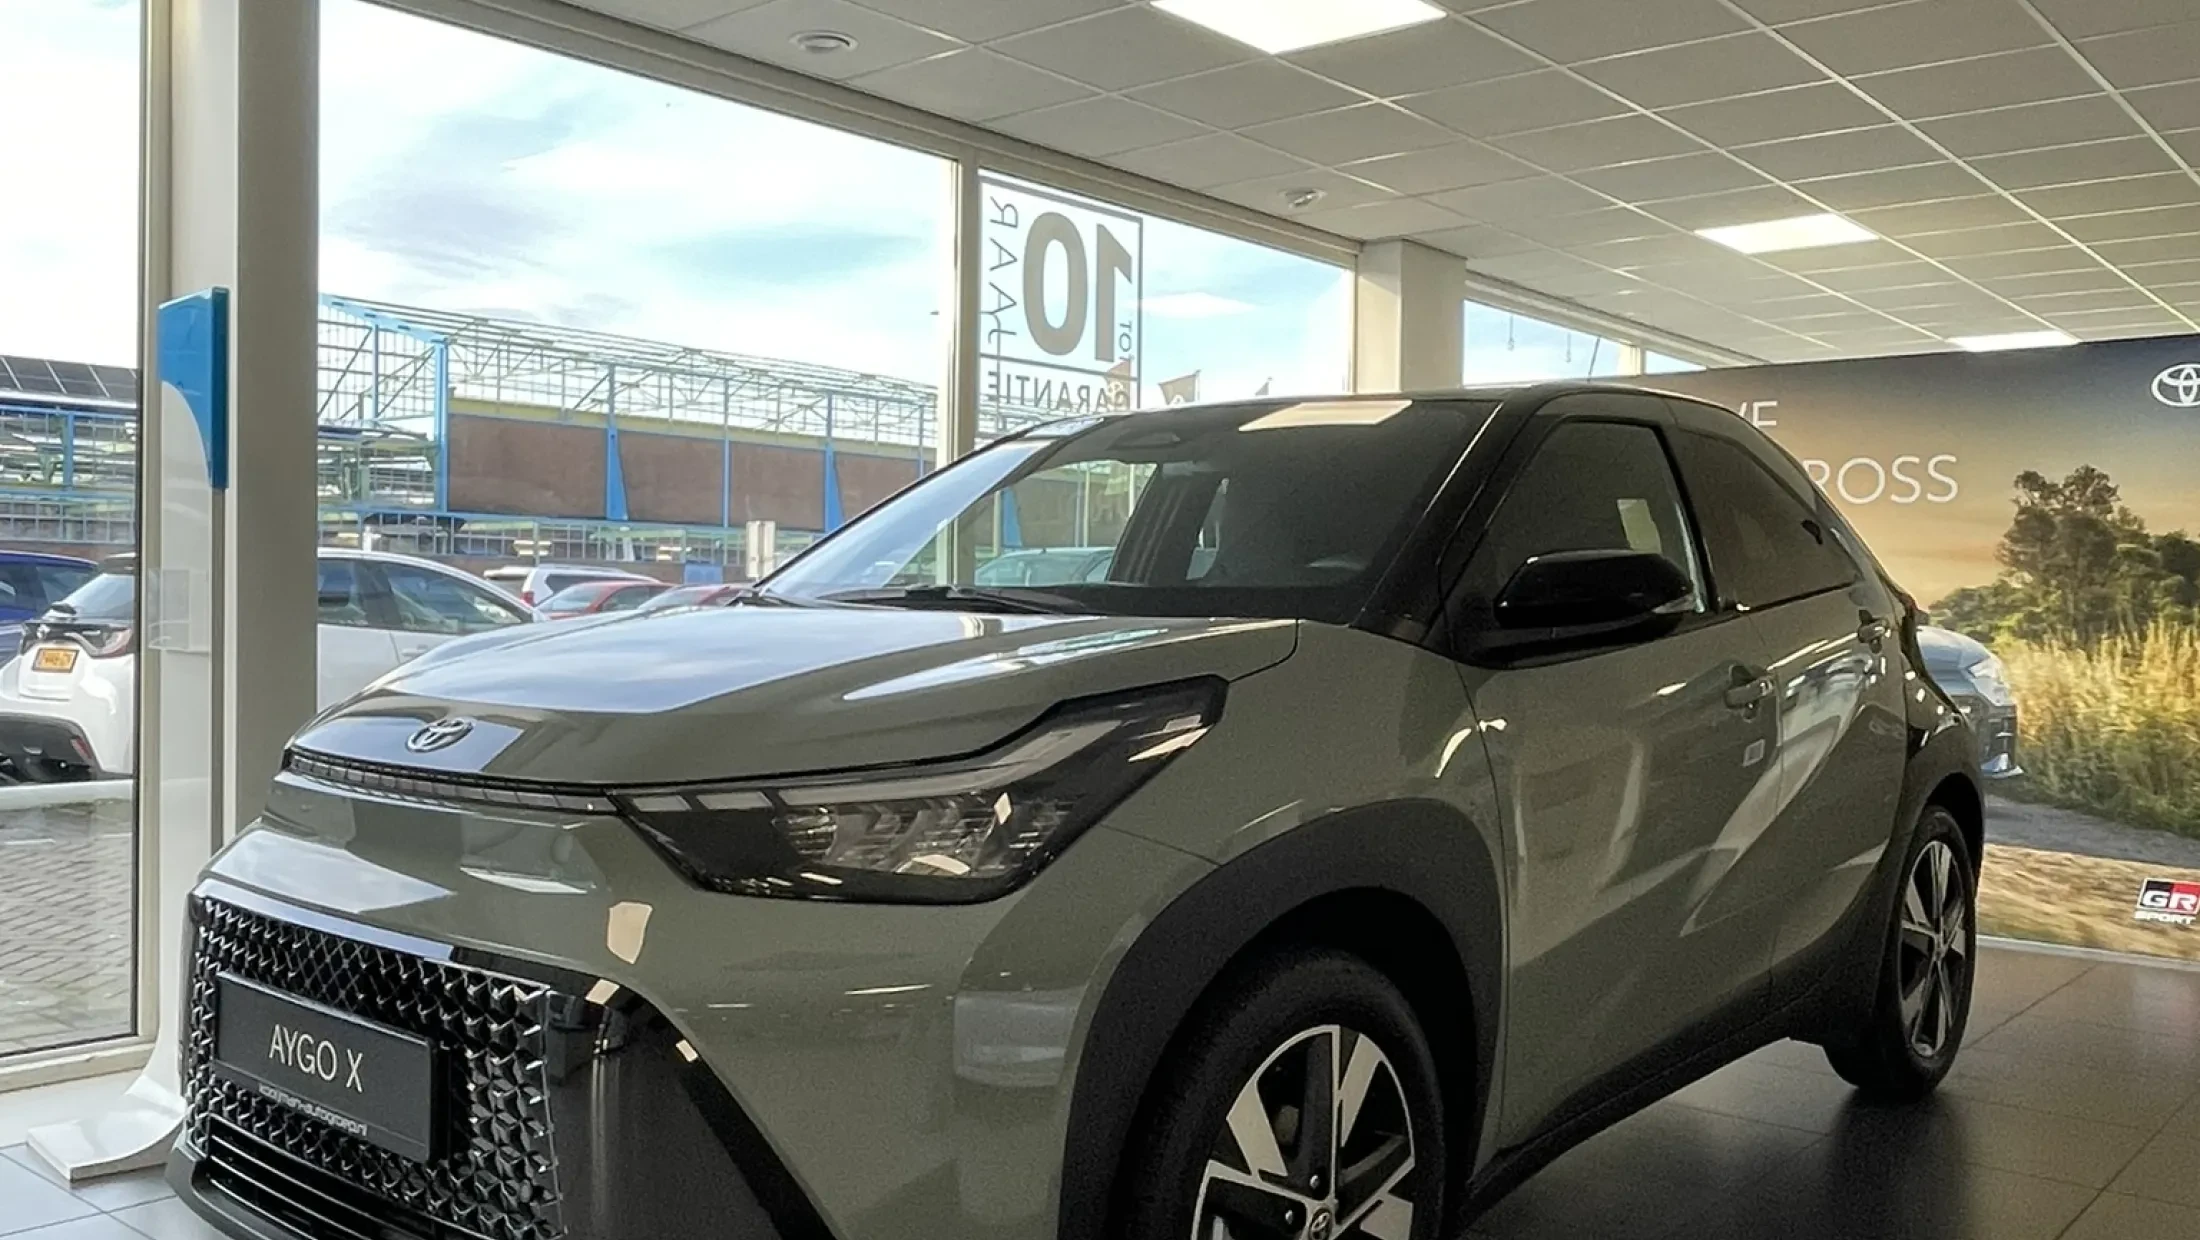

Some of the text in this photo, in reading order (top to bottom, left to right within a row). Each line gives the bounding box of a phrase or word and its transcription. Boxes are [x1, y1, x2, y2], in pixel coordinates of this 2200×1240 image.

[2142, 890, 2198, 912] GR
[2134, 910, 2196, 925] SPORT
[268, 1023, 364, 1093] AYGO X
